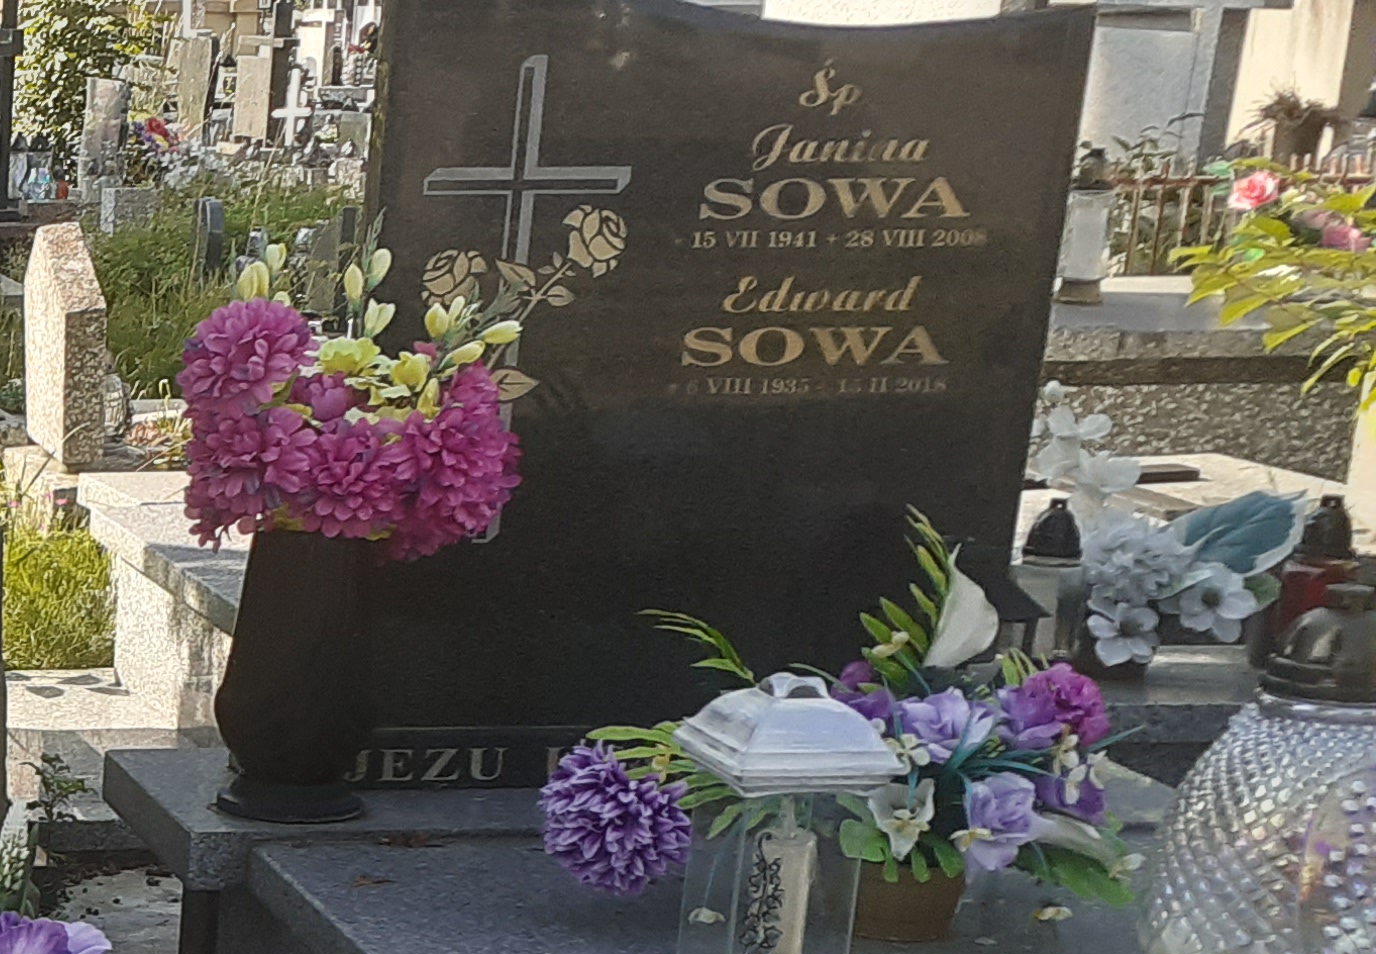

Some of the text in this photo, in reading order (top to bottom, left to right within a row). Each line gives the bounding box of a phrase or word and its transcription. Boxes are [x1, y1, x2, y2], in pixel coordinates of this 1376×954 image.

[698, 176, 971, 221] SOWA
[692, 230, 716, 249] 15
[725, 230, 759, 248] VII
[768, 230, 816, 248] 1941
[845, 230, 874, 248] 28
[882, 229, 925, 248] VIII
[721, 275, 924, 314] Edward
[681, 325, 950, 367] SOWA
[344, 747, 508, 782] JEZU
